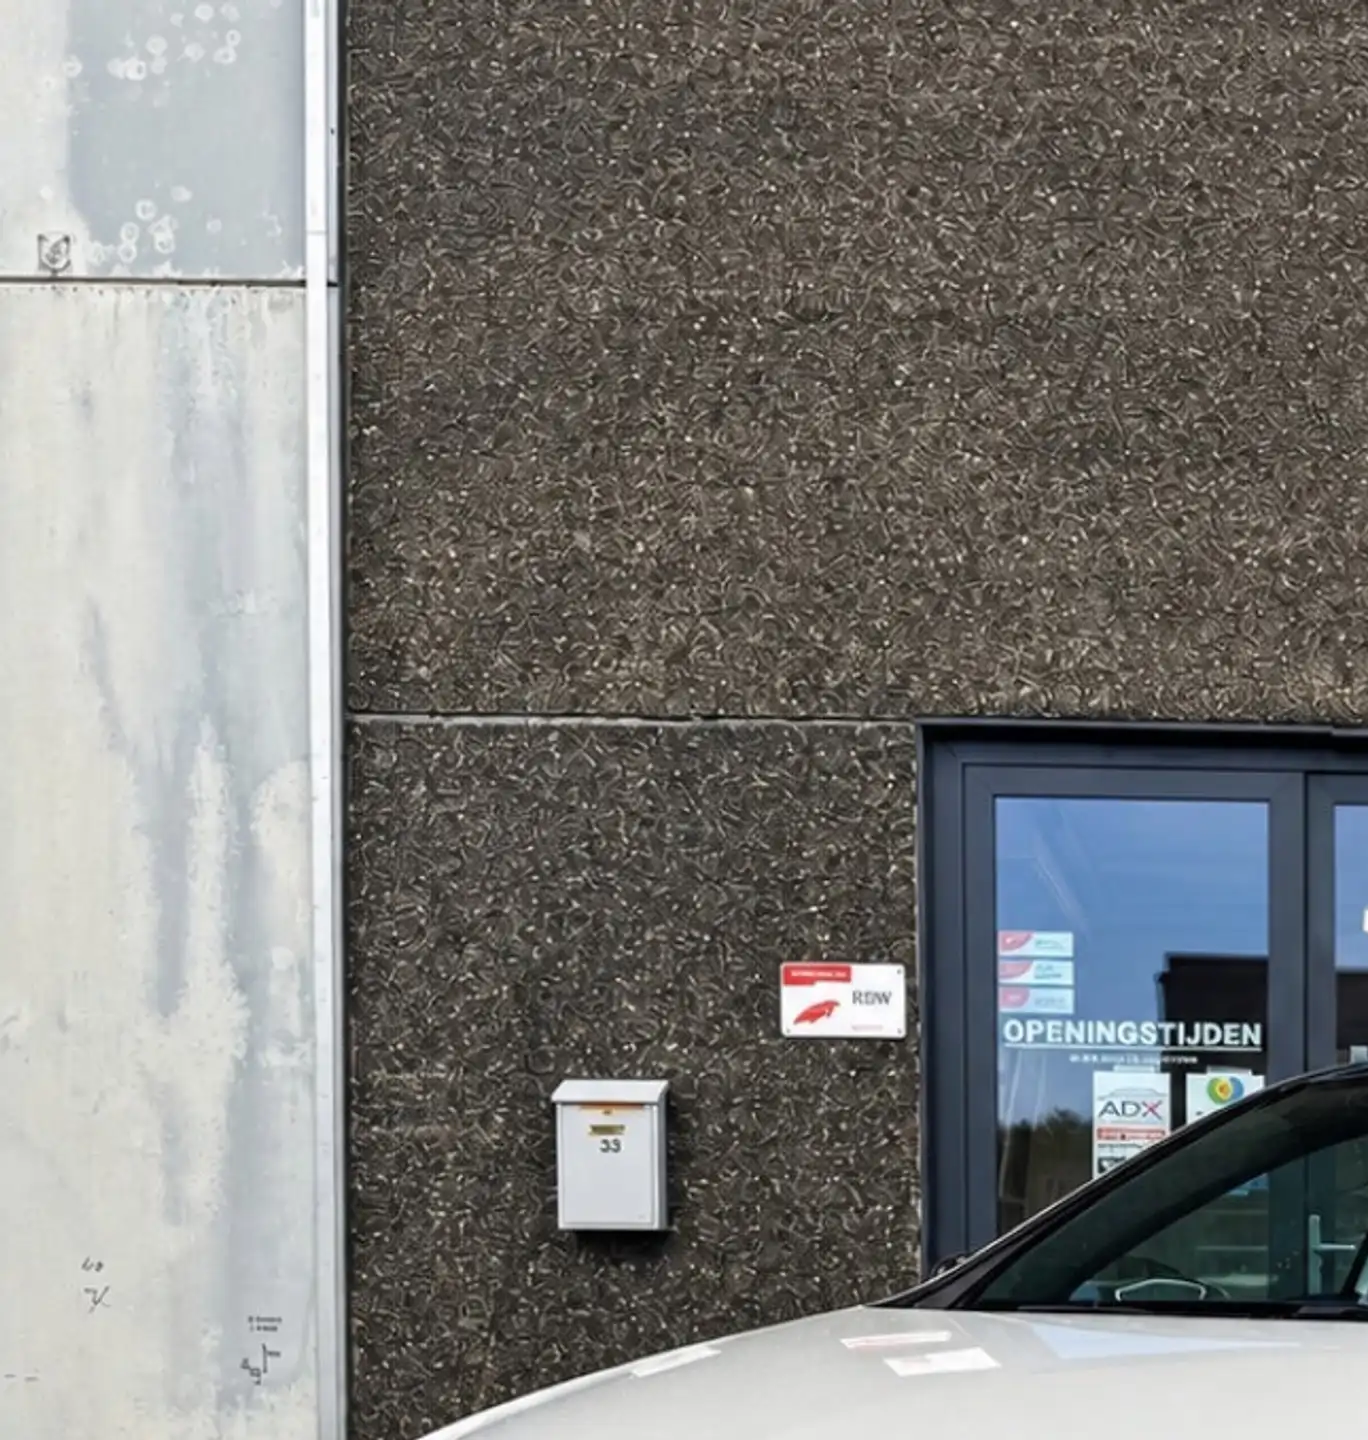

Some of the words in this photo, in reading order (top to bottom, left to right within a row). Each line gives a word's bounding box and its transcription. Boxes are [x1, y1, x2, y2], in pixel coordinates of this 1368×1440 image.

[852, 990, 892, 1005] RDW
[1003, 1019, 1262, 1046] OPENINGSTIJDEN
[1099, 1100, 1163, 1120] ADX
[599, 1139, 622, 1153] 33
